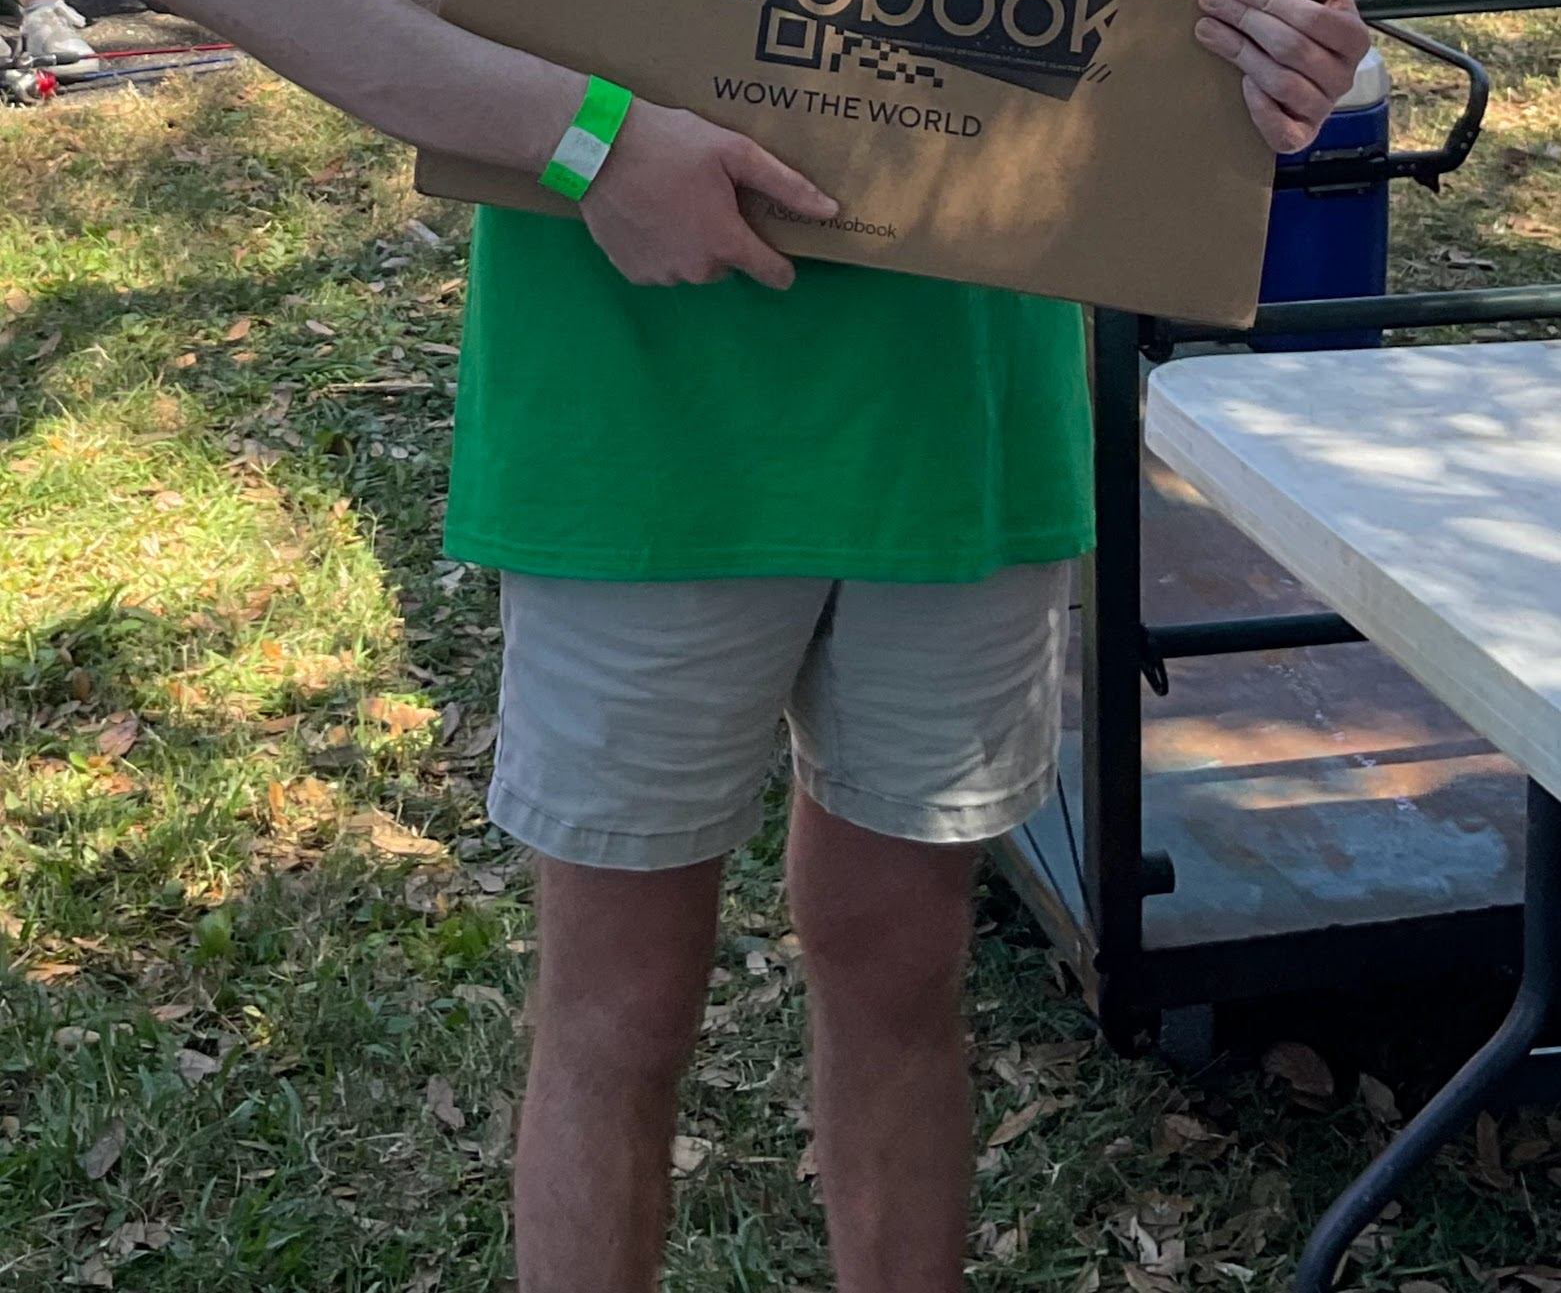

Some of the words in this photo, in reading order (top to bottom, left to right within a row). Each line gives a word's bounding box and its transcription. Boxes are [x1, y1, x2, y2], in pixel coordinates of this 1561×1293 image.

[713, 75, 799, 110] WOW
[803, 90, 862, 120] THE
[868, 99, 982, 138] WORLD
